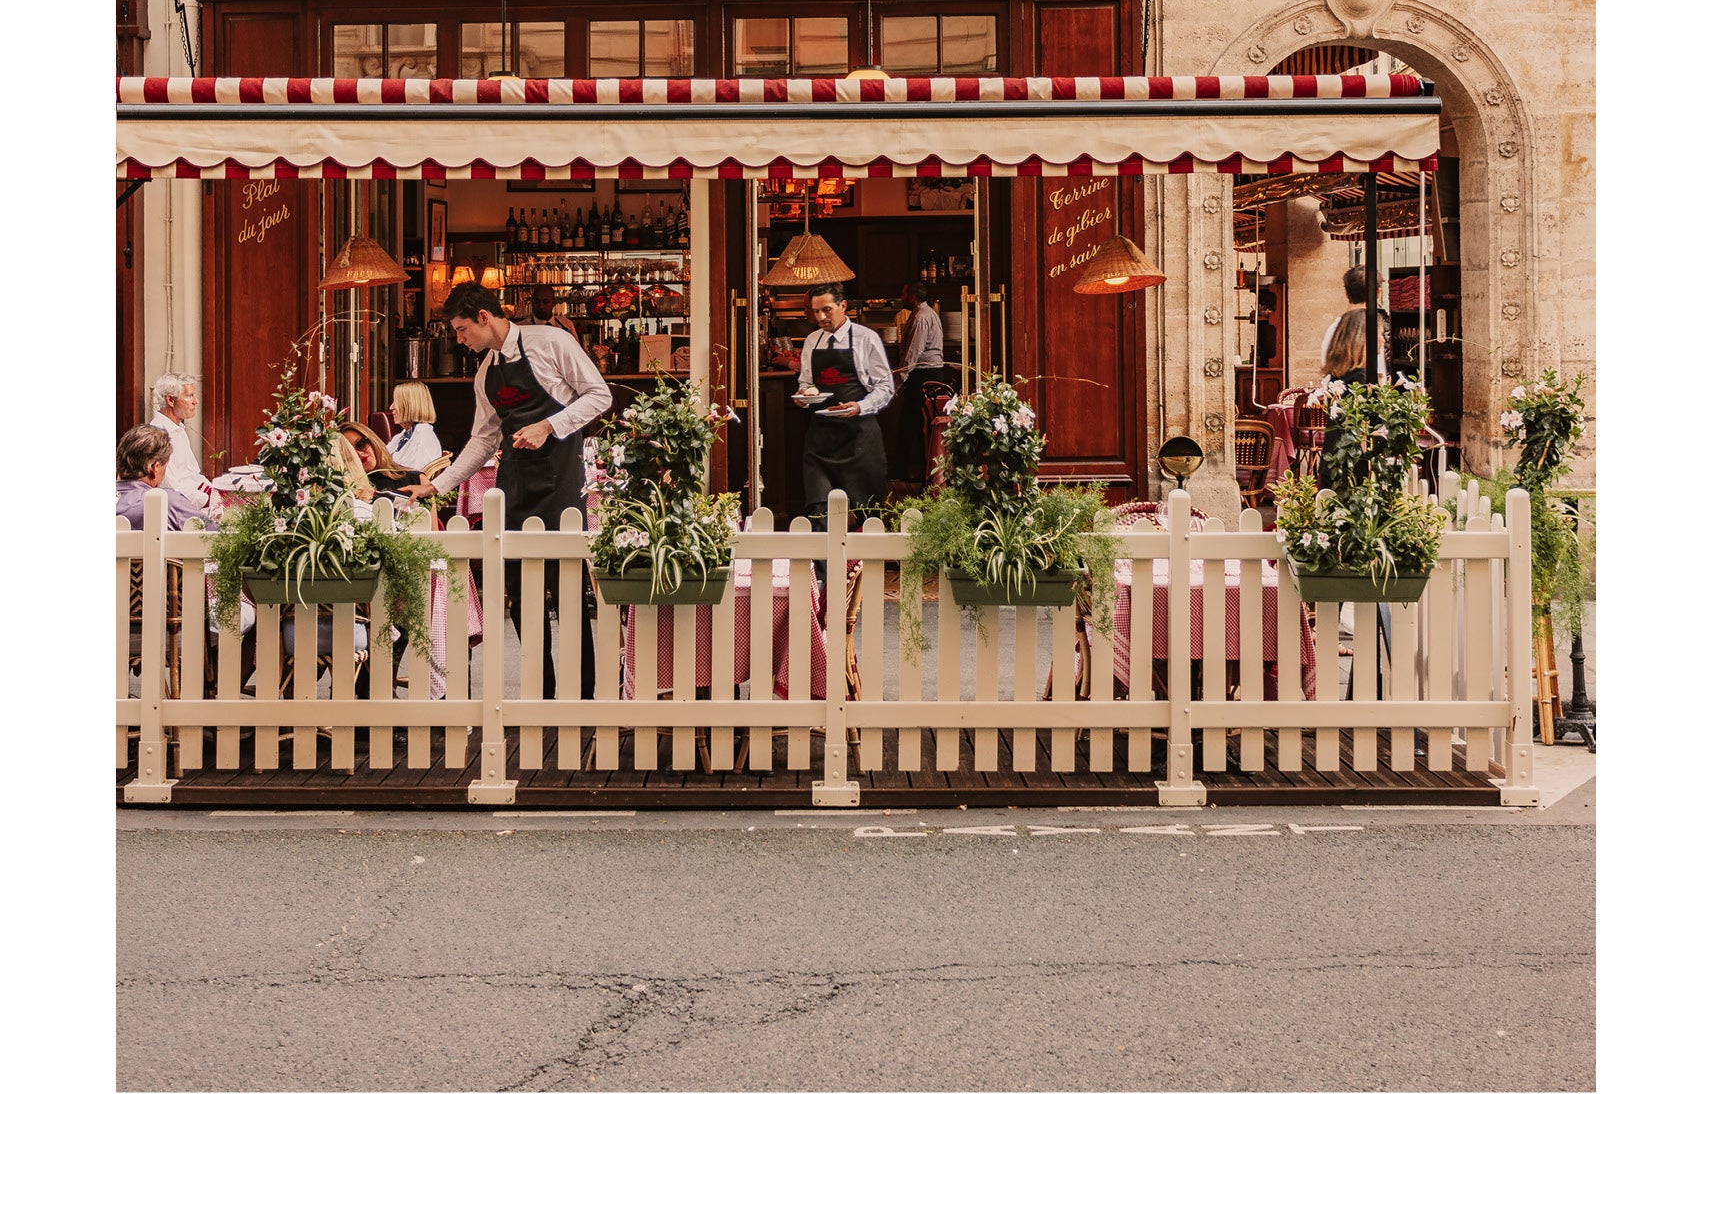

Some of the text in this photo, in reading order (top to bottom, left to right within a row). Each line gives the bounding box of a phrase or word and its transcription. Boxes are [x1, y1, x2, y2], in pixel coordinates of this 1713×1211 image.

[1049, 177, 1111, 211] Terrine
[238, 203, 291, 244] du jour
[1047, 206, 1113, 248] de gibier
[1048, 242, 1102, 279] en sais
